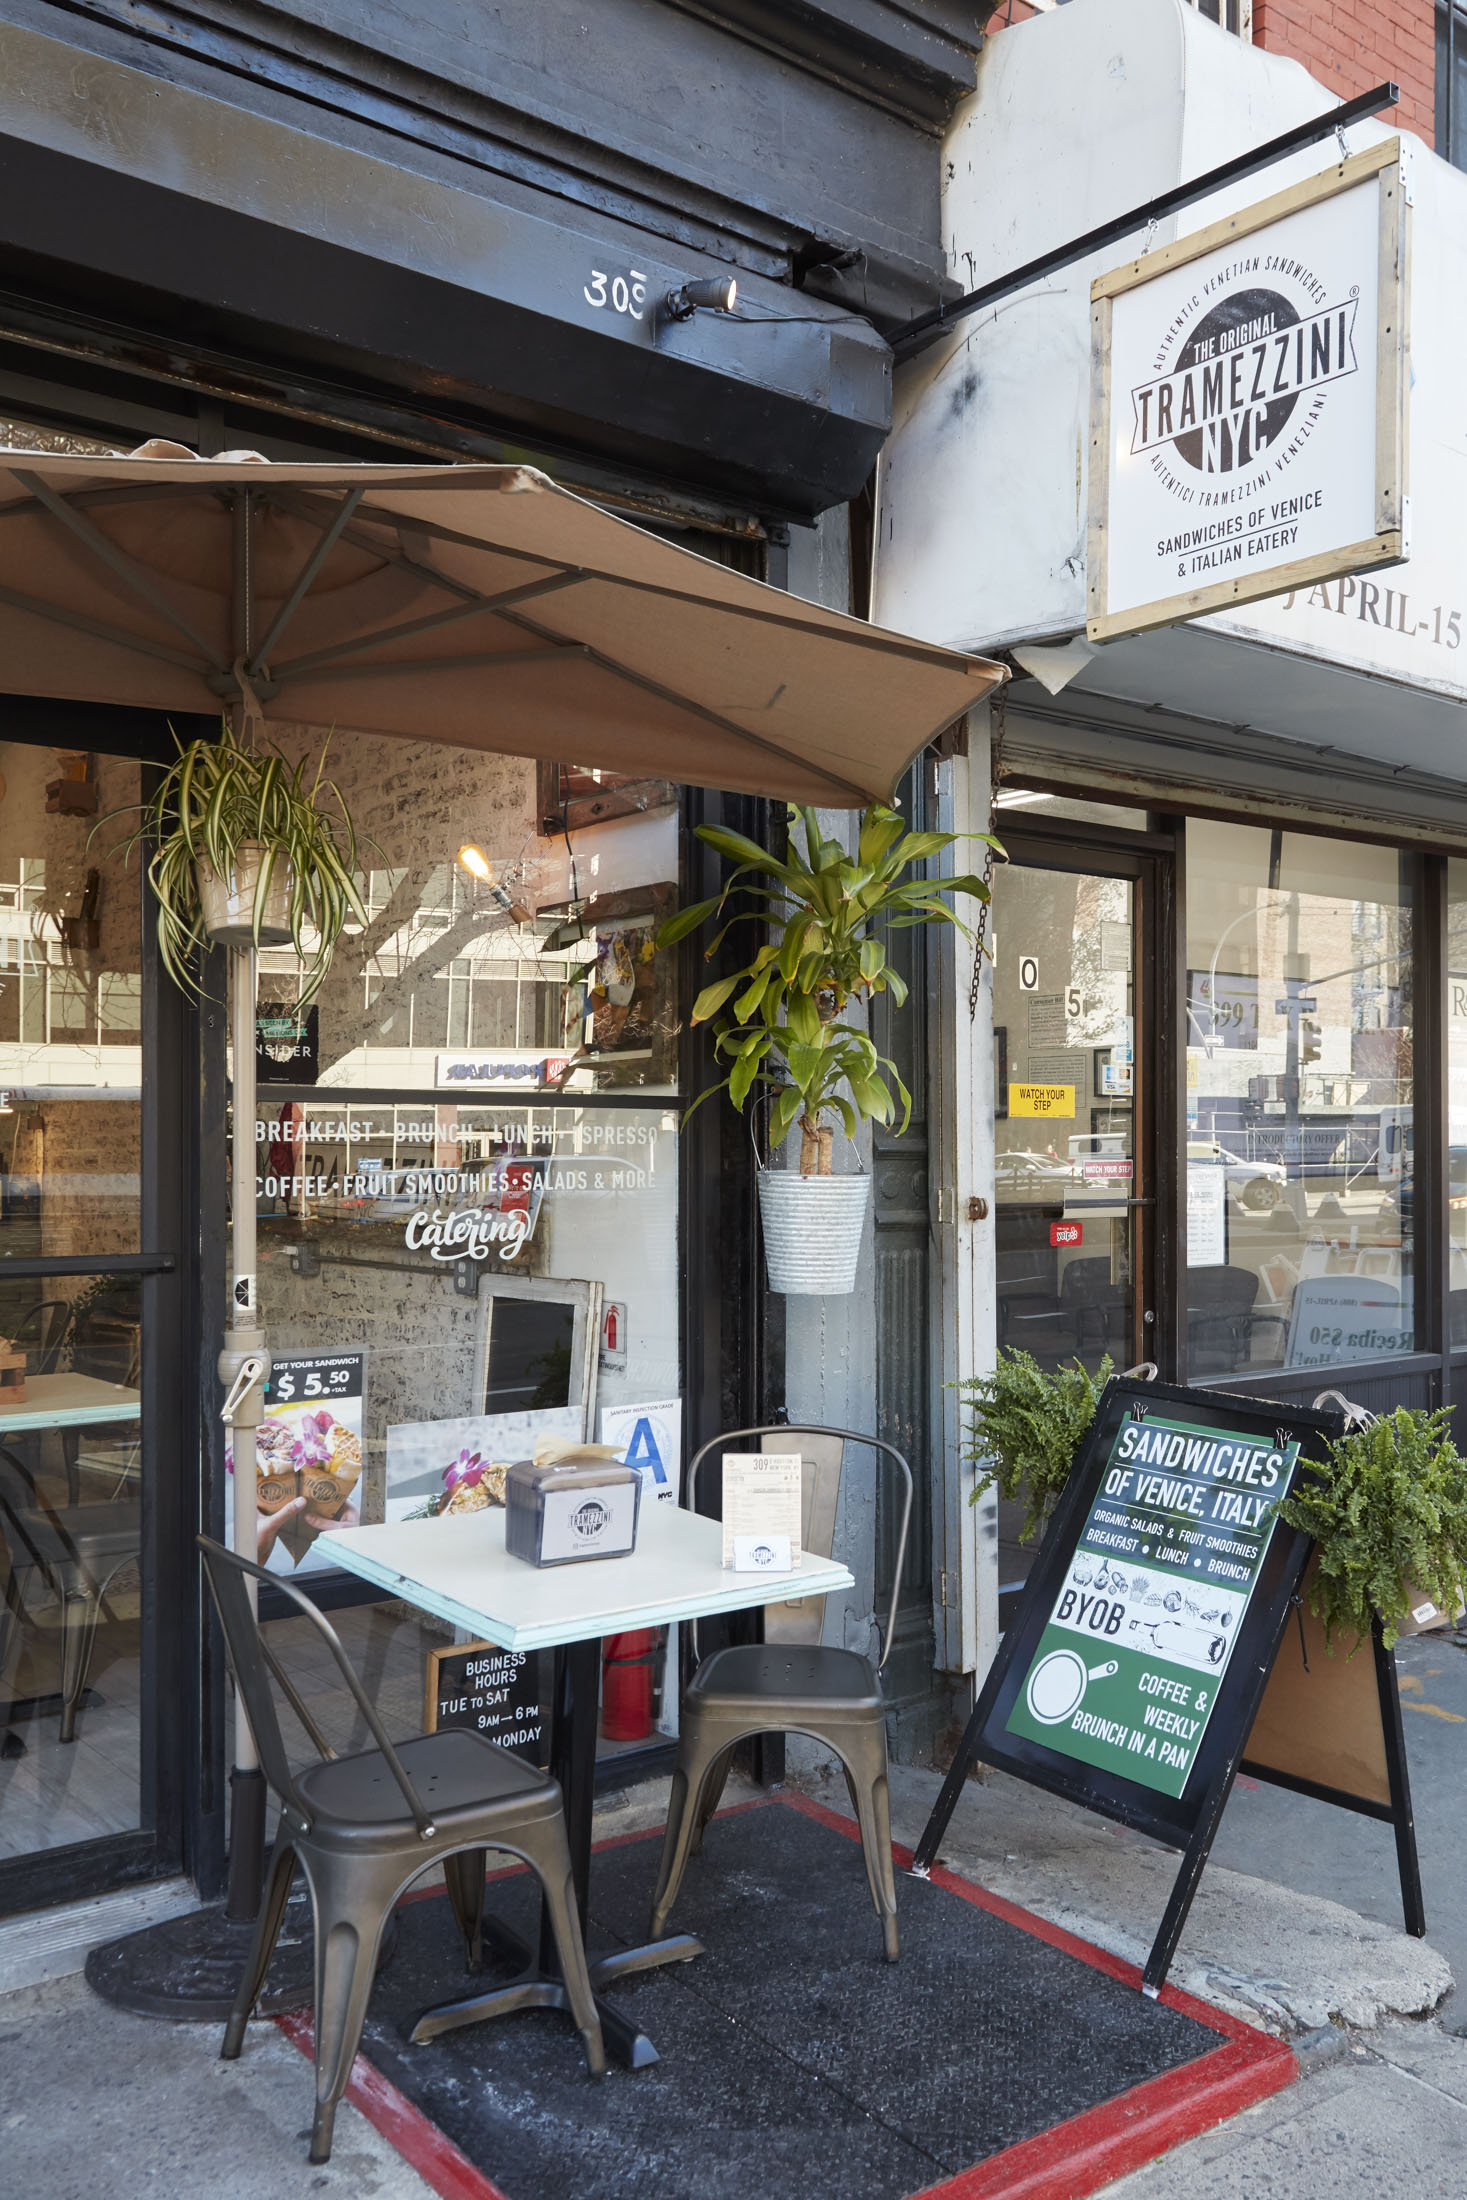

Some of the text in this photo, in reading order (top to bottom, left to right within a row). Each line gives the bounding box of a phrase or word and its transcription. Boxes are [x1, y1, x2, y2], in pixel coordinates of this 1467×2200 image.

[1153, 255, 1327, 371] AUTHENTIC VENETIAN SANDWICHES
[1193, 311, 1277, 364] THE ORIGINAL
[1138, 310, 1346, 444] TRAMEZZINI
[1150, 392, 1328, 507] AUTENTICI TRAMEZZINI VENEZIANI
[1201, 400, 1268, 474] NYC
[1157, 490, 1323, 557] SANDWICHES OF VENICE
[1178, 526, 1299, 577] & ITALIAN EATERY
[256, 1044, 312, 1057] NSIDER
[1020, 1088, 1065, 1100] WATCH YOUR
[1033, 1100, 1052, 1111] STEP
[256, 1121, 657, 1145] BREAKFAST BRUNCH LUNCH ESPRESSO
[256, 1170, 656, 1197] COFFEE FRUIT SMOOTHIES SALADS & MORE
[405, 1209, 531, 1260] Catering
[273, 1357, 359, 1370] GET YOUR SANDWICH
[624, 1417, 668, 1485] A
[753, 1459, 768, 1471] 309
[1118, 1427, 1283, 1488] SANDWICHES
[658, 1491, 673, 1500] NYC
[1104, 1468, 1269, 1528] OF VENICE, ITALY
[570, 1511, 611, 1527] TRAMEZZINI
[1093, 1509, 1258, 1559] ORGANIC SALADS & FRUIT SMOOTHIES
[1086, 1528, 1251, 1582] BREAKFAST LUNCH BRUNCH
[1055, 1588, 1126, 1637] BYOB
[466, 1652, 526, 1676] BUSINESS
[475, 1669, 517, 1689] HOURS
[440, 1688, 510, 1715] TUE TO SAT
[1138, 1672, 1208, 1713] COFFEE &
[493, 1726, 542, 1747] MONDAY
[1070, 1710, 1190, 1771] BRUNCH IN A PAN
[1143, 1705, 1200, 1741] WEEKLY
